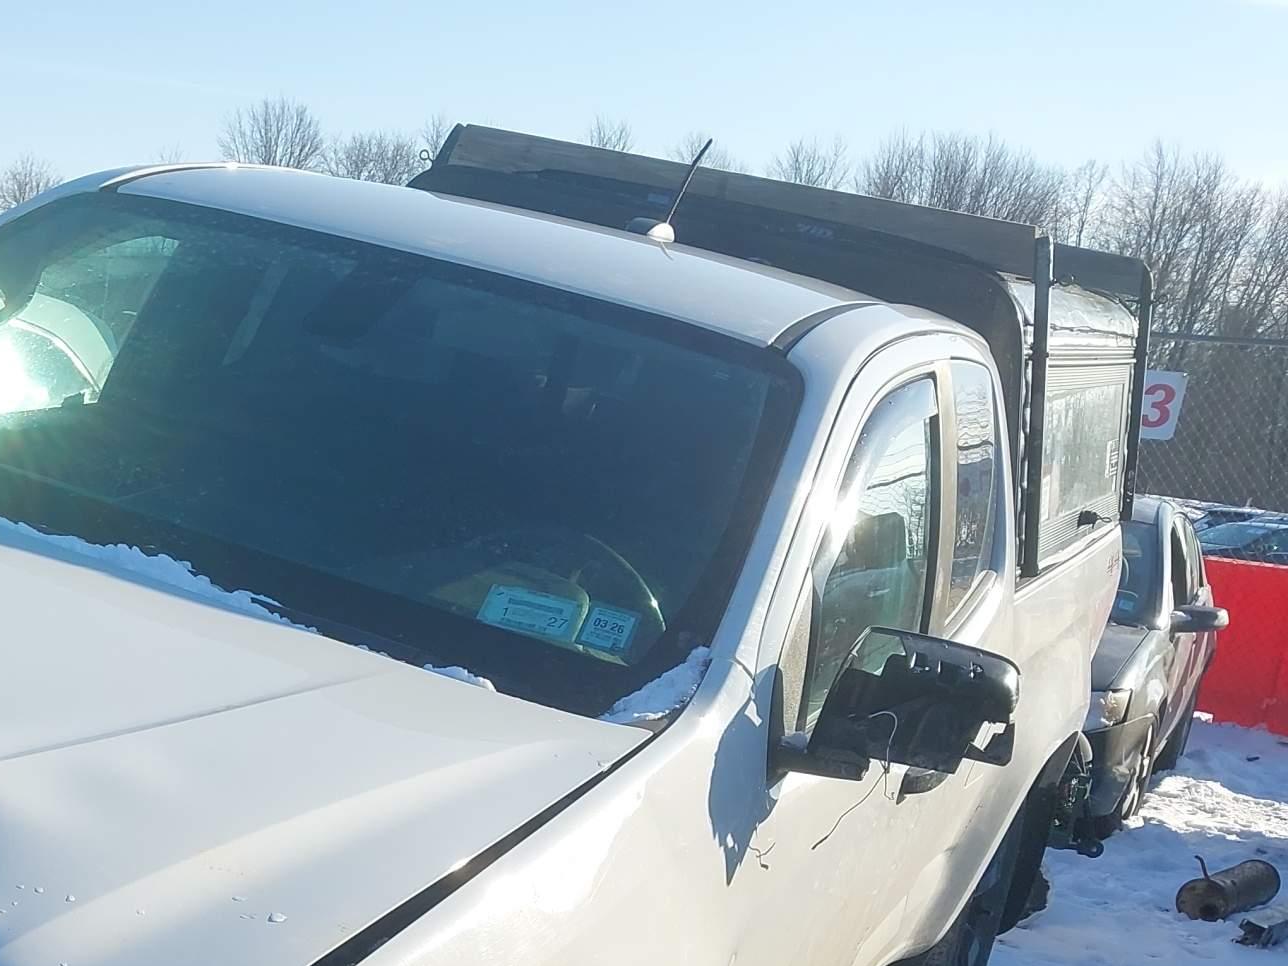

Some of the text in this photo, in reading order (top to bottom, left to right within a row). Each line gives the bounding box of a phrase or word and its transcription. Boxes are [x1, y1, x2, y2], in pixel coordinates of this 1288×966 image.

[1141, 383, 1176, 428] 3
[546, 616, 569, 629] 27
[593, 617, 609, 629] 03
[610, 622, 625, 634] 26
